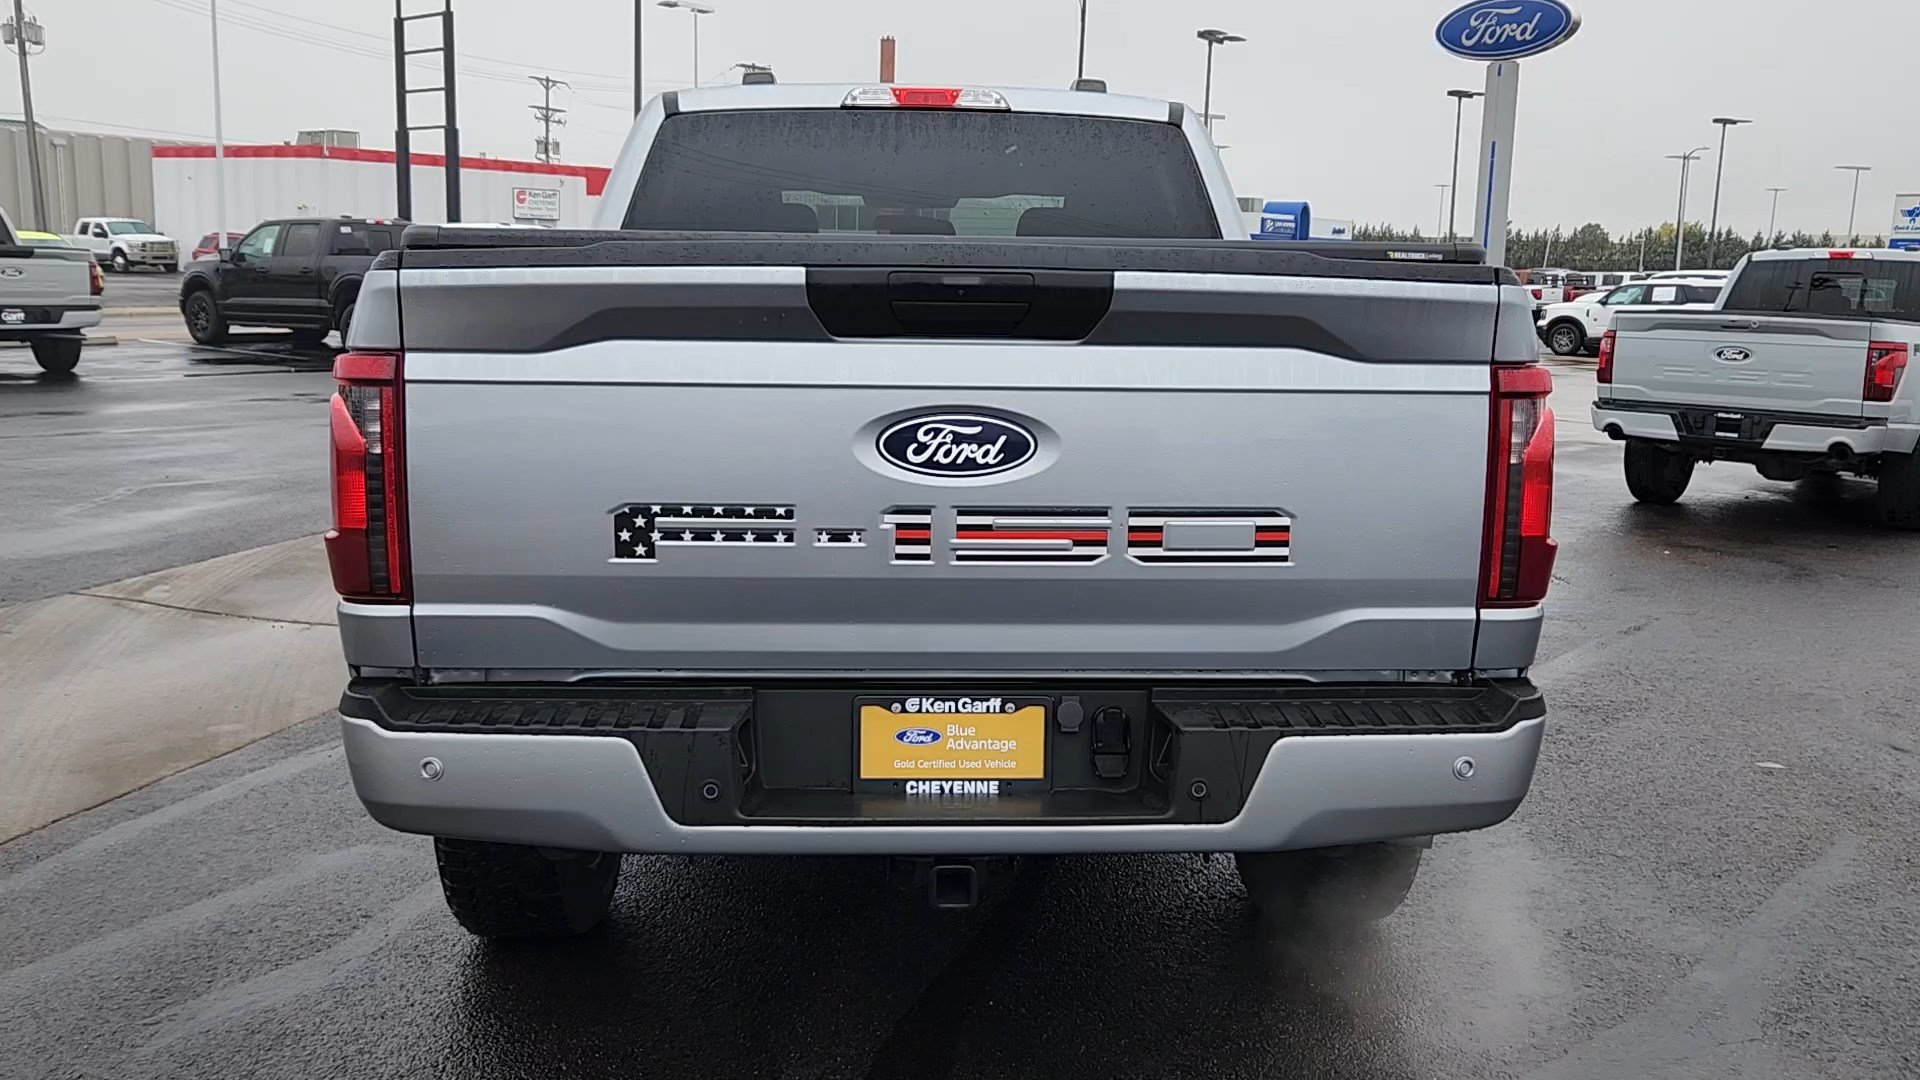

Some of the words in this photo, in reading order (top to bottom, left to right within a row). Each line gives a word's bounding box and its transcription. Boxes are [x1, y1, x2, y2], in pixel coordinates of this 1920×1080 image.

[1460, 6, 1542, 47] Ford
[1720, 348, 1746, 360] Ford
[906, 423, 1008, 464] Ford
[607, 503, 1296, 568] F-150
[921, 698, 956, 713] Ken
[957, 697, 1002, 713] Garff
[902, 729, 934, 743] Ford
[946, 724, 976, 737] Blue
[946, 738, 1017, 752] Advantage
[893, 759, 915, 769] Gold
[917, 759, 956, 769] Certified
[958, 760, 982, 769] Used
[984, 760, 1017, 769] Vehicle
[905, 780, 1000, 794] CHEYENNE
